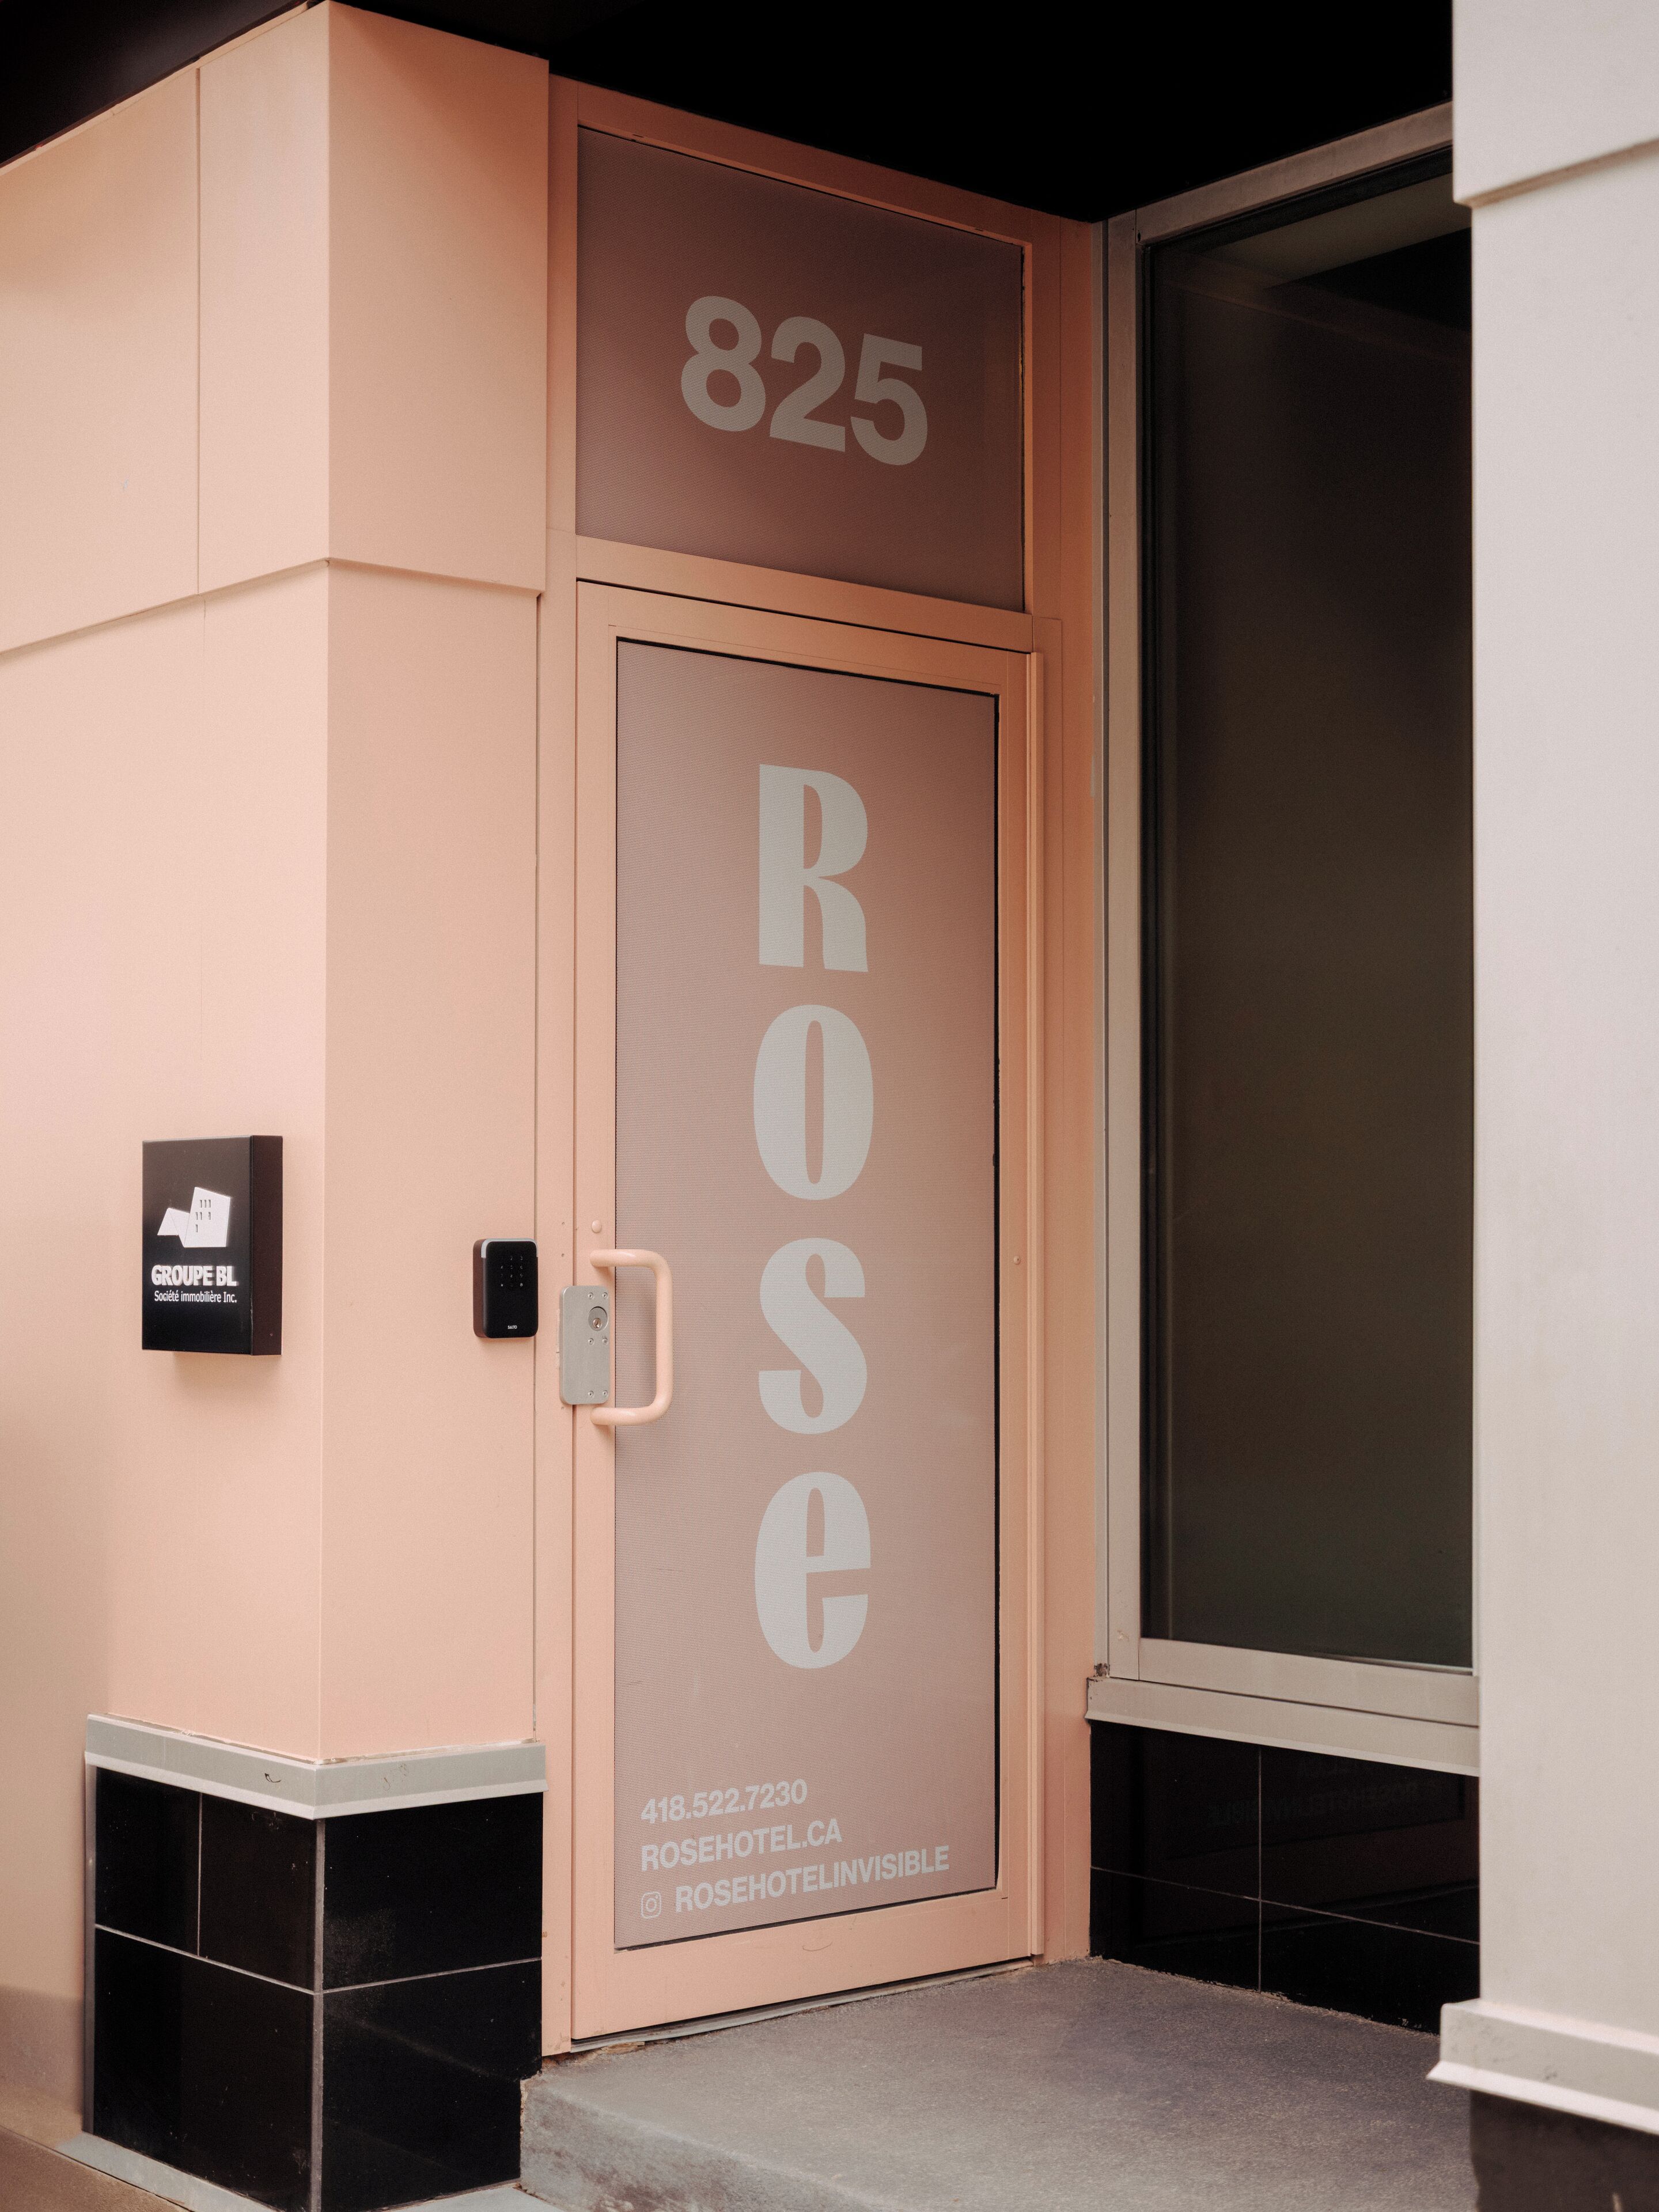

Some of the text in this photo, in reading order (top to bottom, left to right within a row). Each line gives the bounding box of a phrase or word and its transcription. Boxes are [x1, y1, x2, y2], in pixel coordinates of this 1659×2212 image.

[681, 296, 928, 465] 825
[753, 763, 874, 1669] Rose
[151, 1264, 238, 1286] GROUPE BL
[154, 1290, 237, 1303] Société immobilière Inc.
[641, 1779, 808, 1824] 418.522.7230
[641, 1818, 843, 1872] ROSEHOTEL.CA
[675, 1845, 950, 1913] ROSEHOTELINVISIBLE
